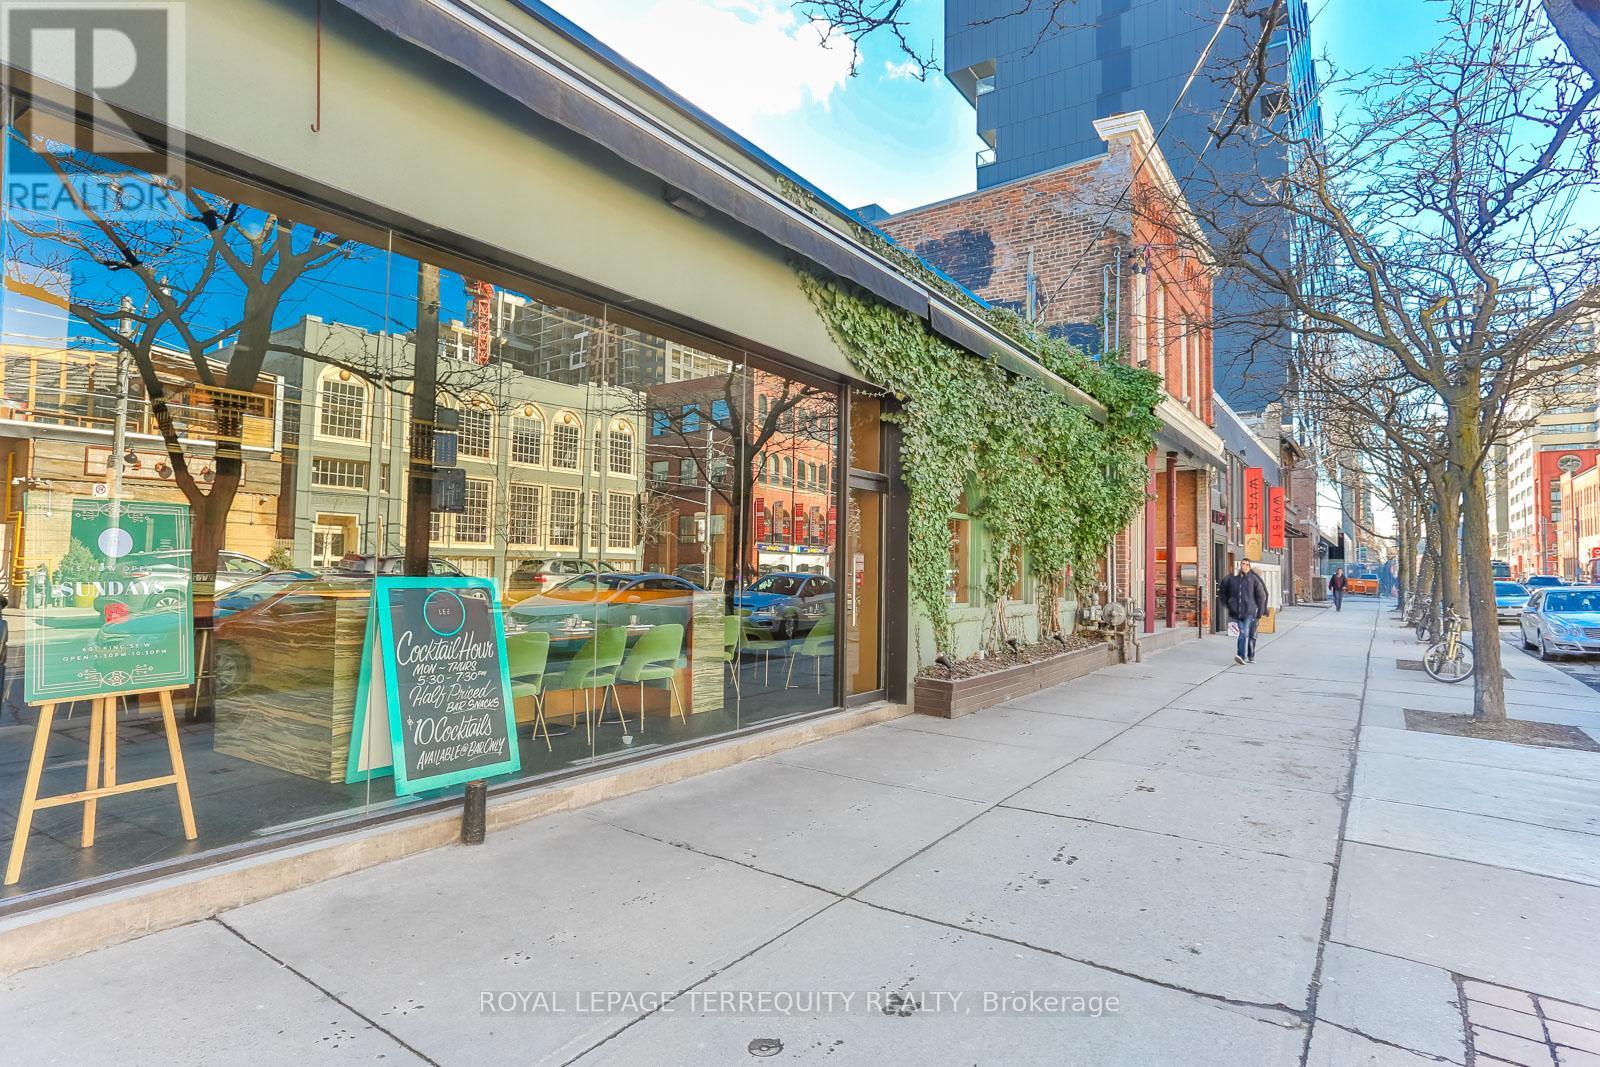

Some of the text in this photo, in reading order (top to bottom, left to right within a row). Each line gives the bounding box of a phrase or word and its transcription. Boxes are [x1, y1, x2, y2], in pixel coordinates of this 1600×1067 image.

[1249, 478, 1258, 529] WVRST
[1272, 495, 1281, 538] WVRST
[60, 580, 165, 598] SUNDAYS
[438, 608, 451, 616] LEE
[396, 630, 494, 666] Cocktail Hour
[412, 662, 437, 677] MON
[448, 660, 477, 673] THURS
[416, 674, 445, 686] 5:30
[409, 680, 497, 709] Half Priced
[446, 697, 500, 713] BAR SNACKS
[434, 713, 492, 742] Cocktails
[416, 744, 461, 770] AVAILABLE
[467, 741, 485, 757] BAR
[484, 737, 506, 756] ONLY
